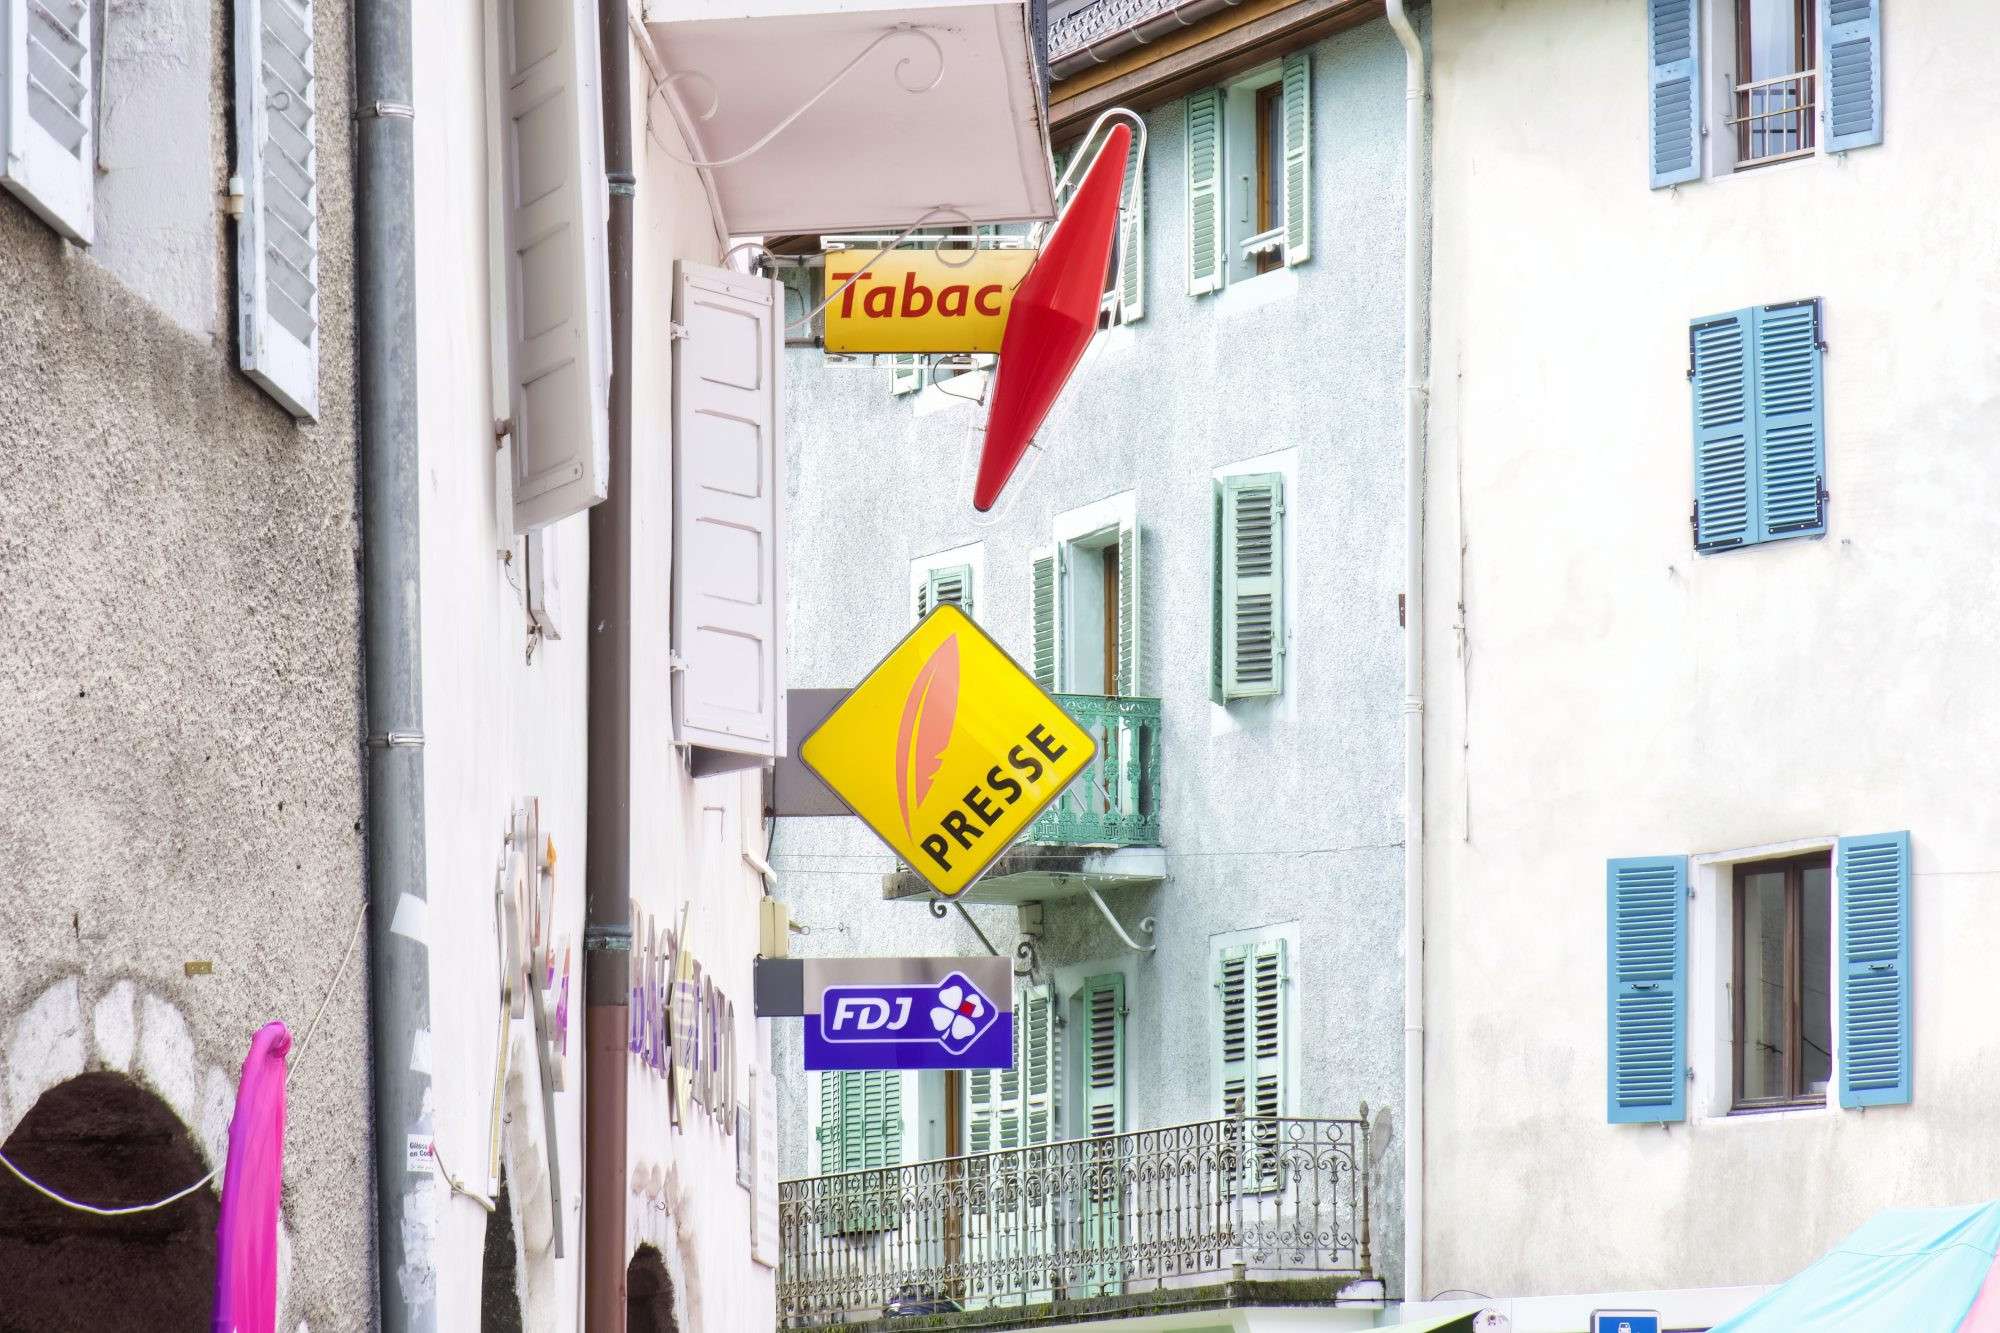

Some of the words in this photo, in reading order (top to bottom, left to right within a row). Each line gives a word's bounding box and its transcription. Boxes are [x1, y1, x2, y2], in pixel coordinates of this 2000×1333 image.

[831, 271, 1003, 319] Tabac
[919, 723, 1069, 873] PRESSE
[832, 997, 913, 1031] FDJ
